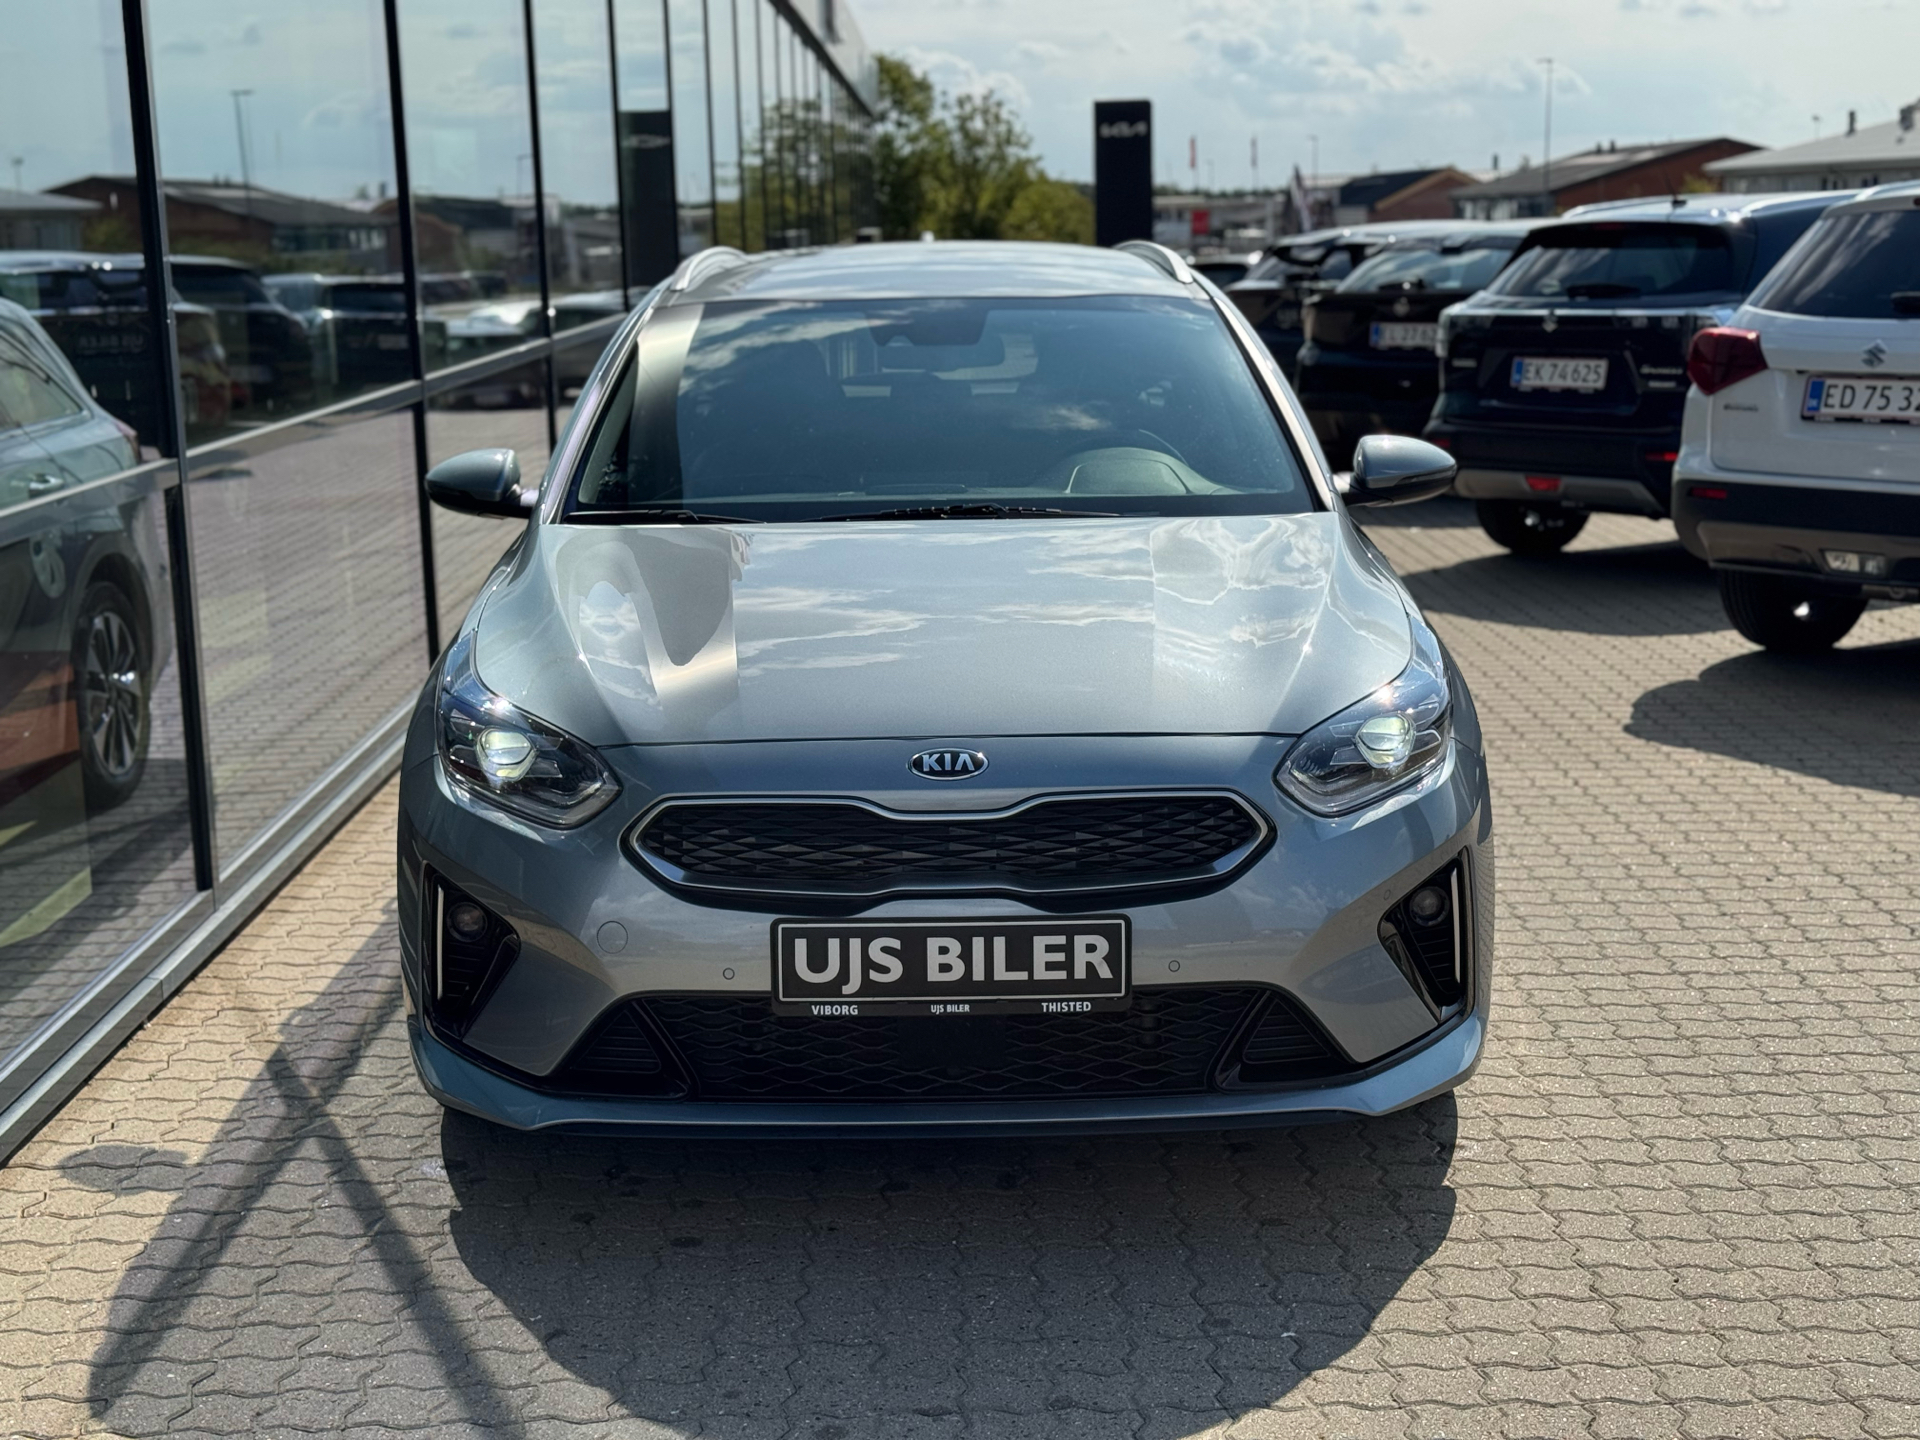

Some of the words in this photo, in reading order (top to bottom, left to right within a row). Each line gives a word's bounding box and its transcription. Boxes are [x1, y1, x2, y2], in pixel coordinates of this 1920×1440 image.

[1522, 362, 1543, 381] EK
[1824, 384, 1856, 409] ED
[1863, 385, 1893, 411] 75
[922, 753, 975, 772] KIA
[794, 937, 904, 995] UJS
[926, 934, 1114, 983] BILER
[811, 1004, 859, 1016] VIBORG
[930, 1004, 945, 1014] UJS
[946, 1003, 971, 1014] BILER
[1041, 1001, 1092, 1013] THISTED
